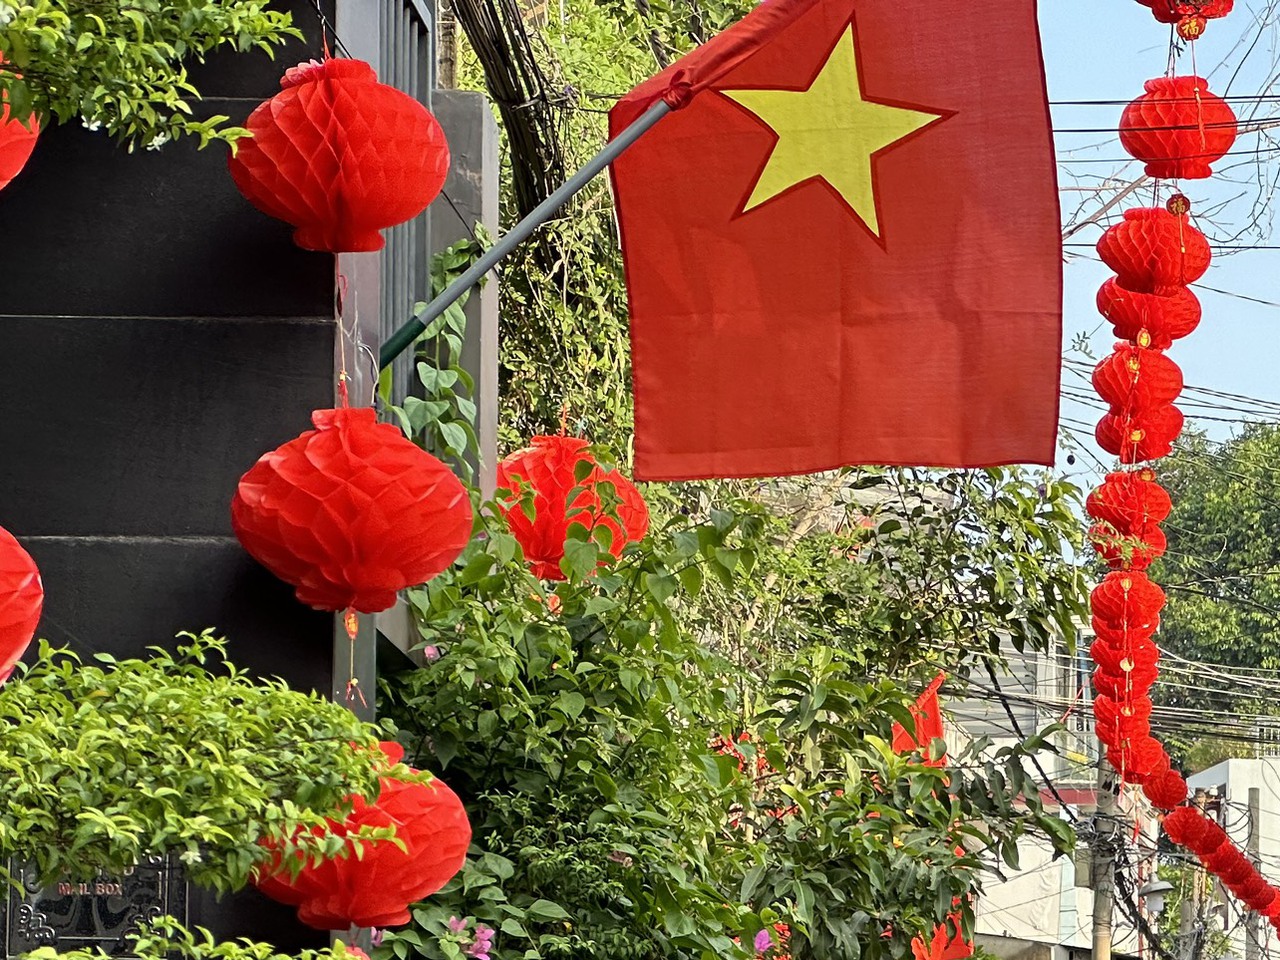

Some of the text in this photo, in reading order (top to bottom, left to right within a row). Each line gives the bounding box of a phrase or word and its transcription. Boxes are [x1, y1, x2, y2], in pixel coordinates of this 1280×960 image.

[1181, 19, 1199, 35] 福
[1172, 198, 1185, 214] 福
[95, 883, 122, 895] BOX
